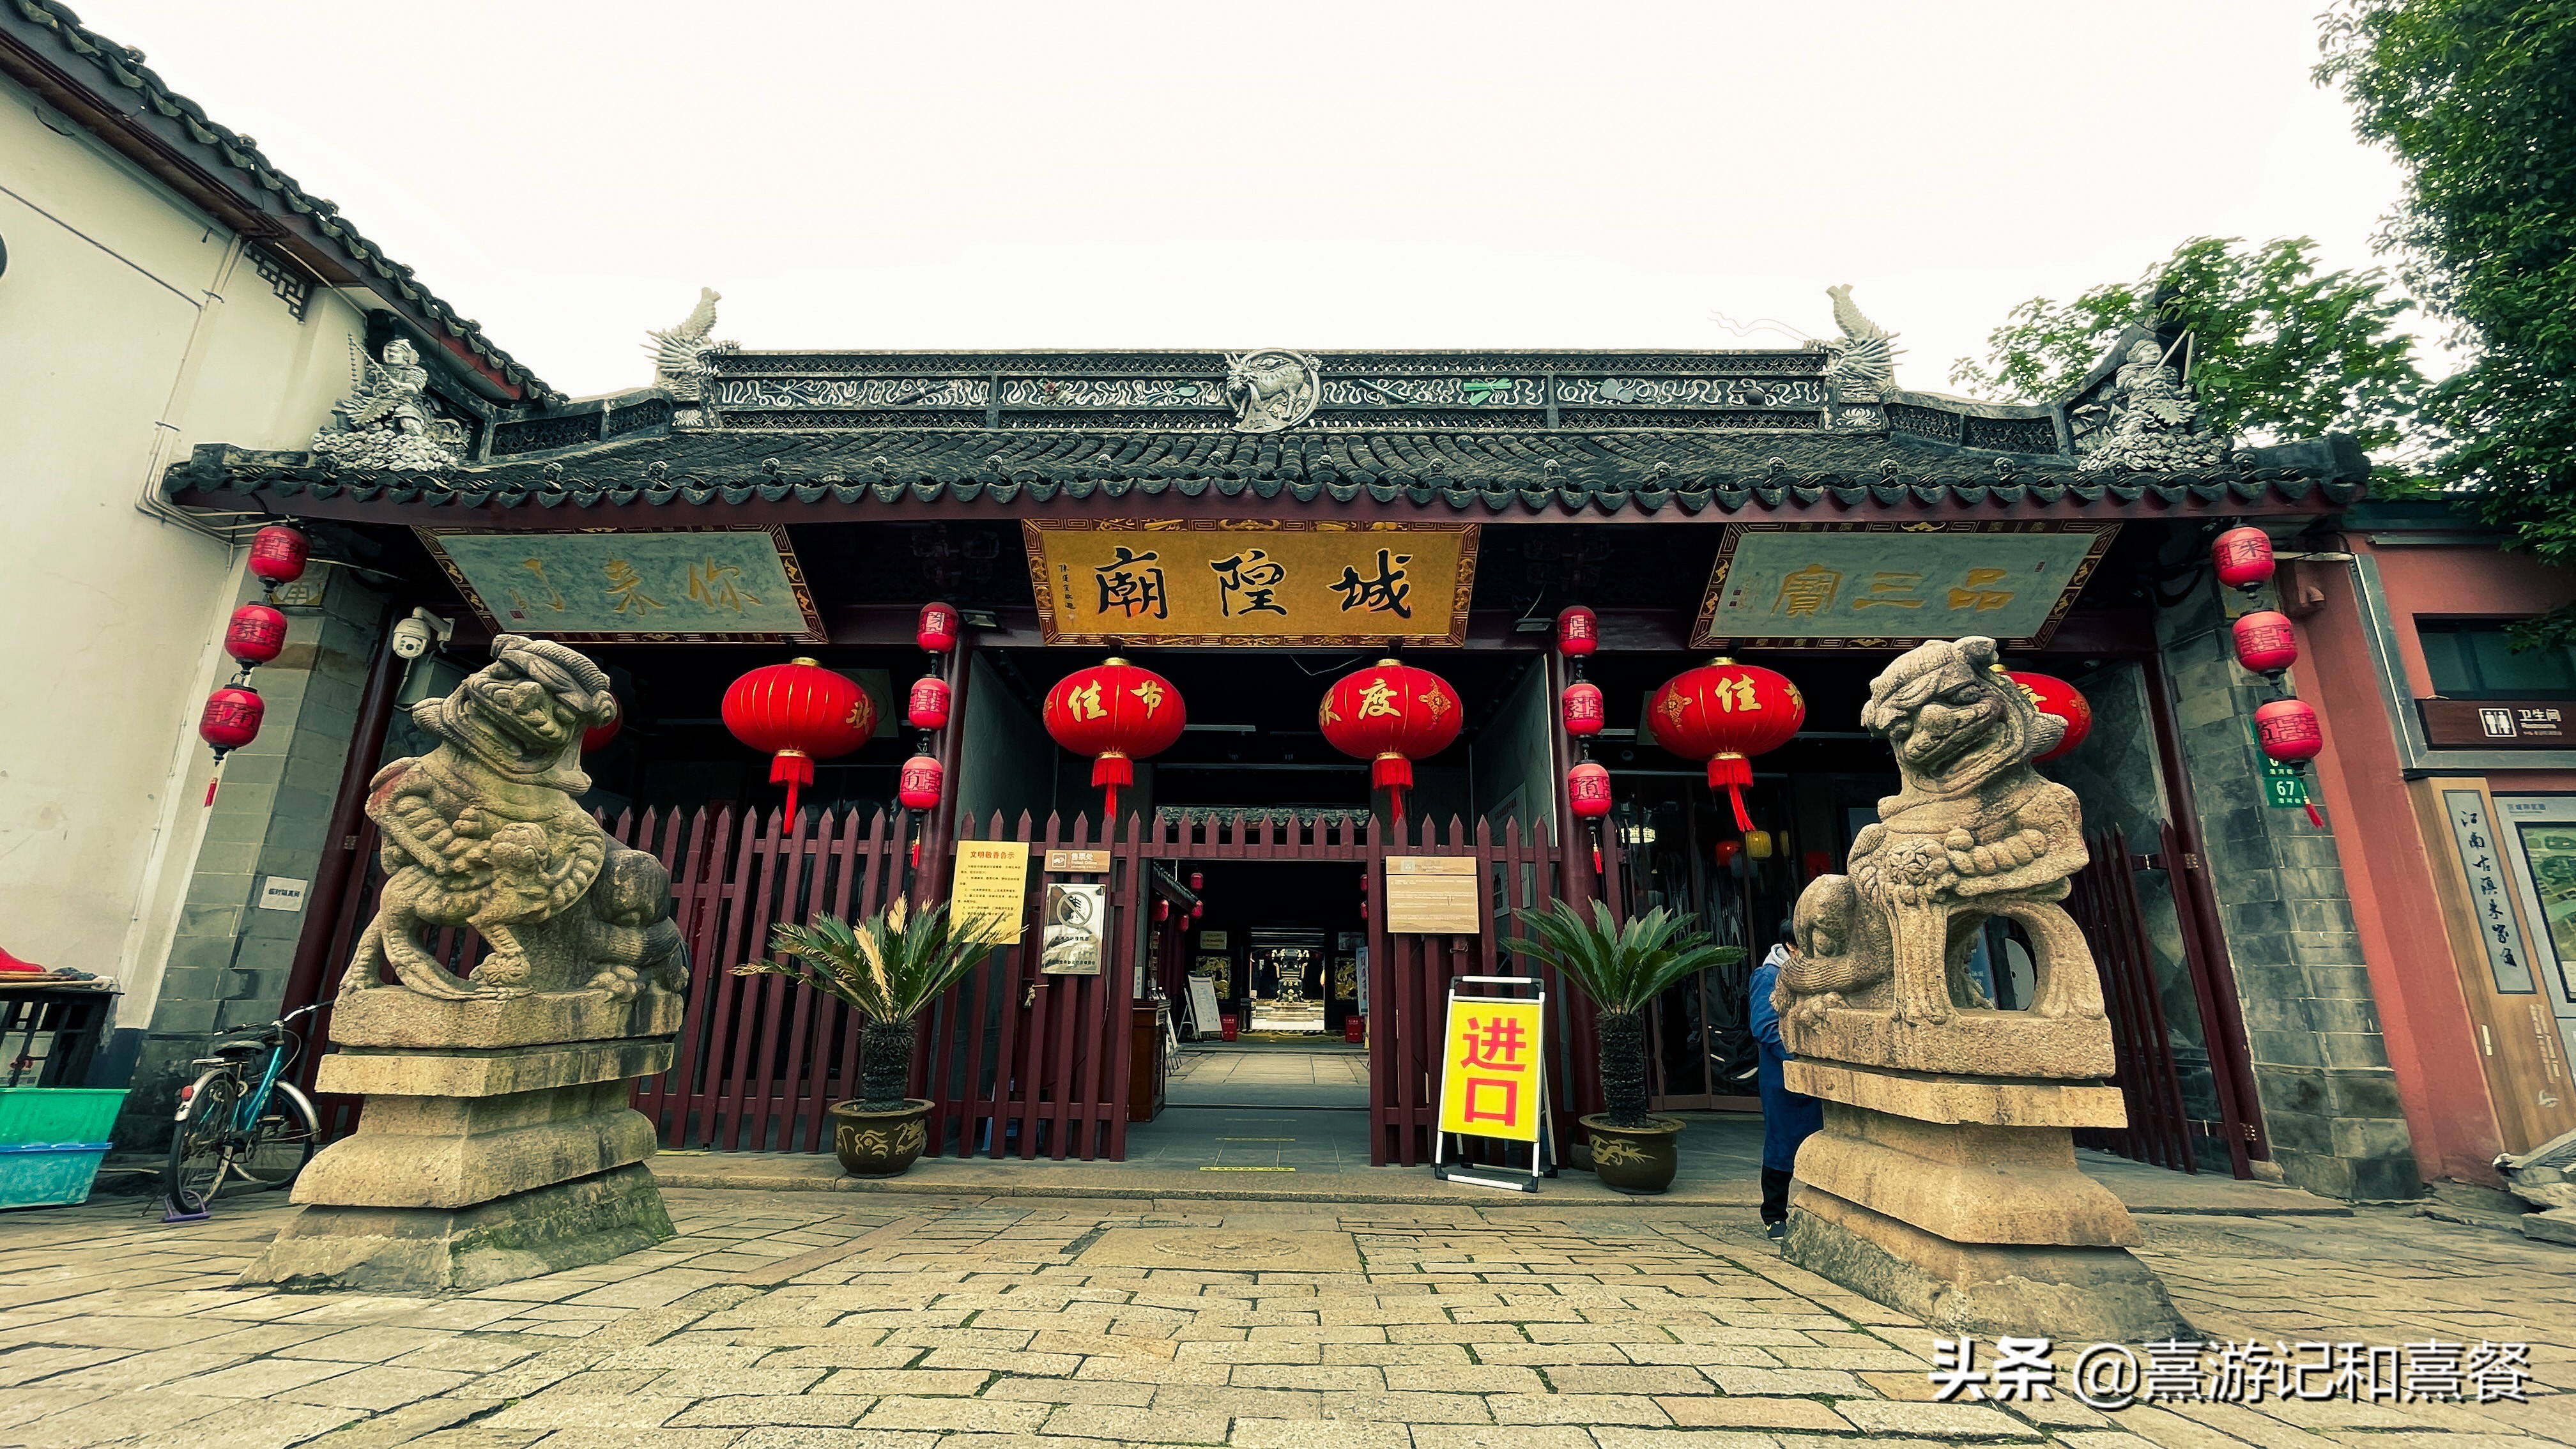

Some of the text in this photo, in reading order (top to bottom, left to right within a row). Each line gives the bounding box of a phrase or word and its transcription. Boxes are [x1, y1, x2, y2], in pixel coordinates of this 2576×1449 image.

[1094, 546, 1413, 619] 城隍廟
[1068, 679, 1165, 722] 佳节
[2517, 708, 2562, 722] 卫生间
[2276, 781, 2294, 796] 67
[1460, 1016, 1527, 1127] 进口
